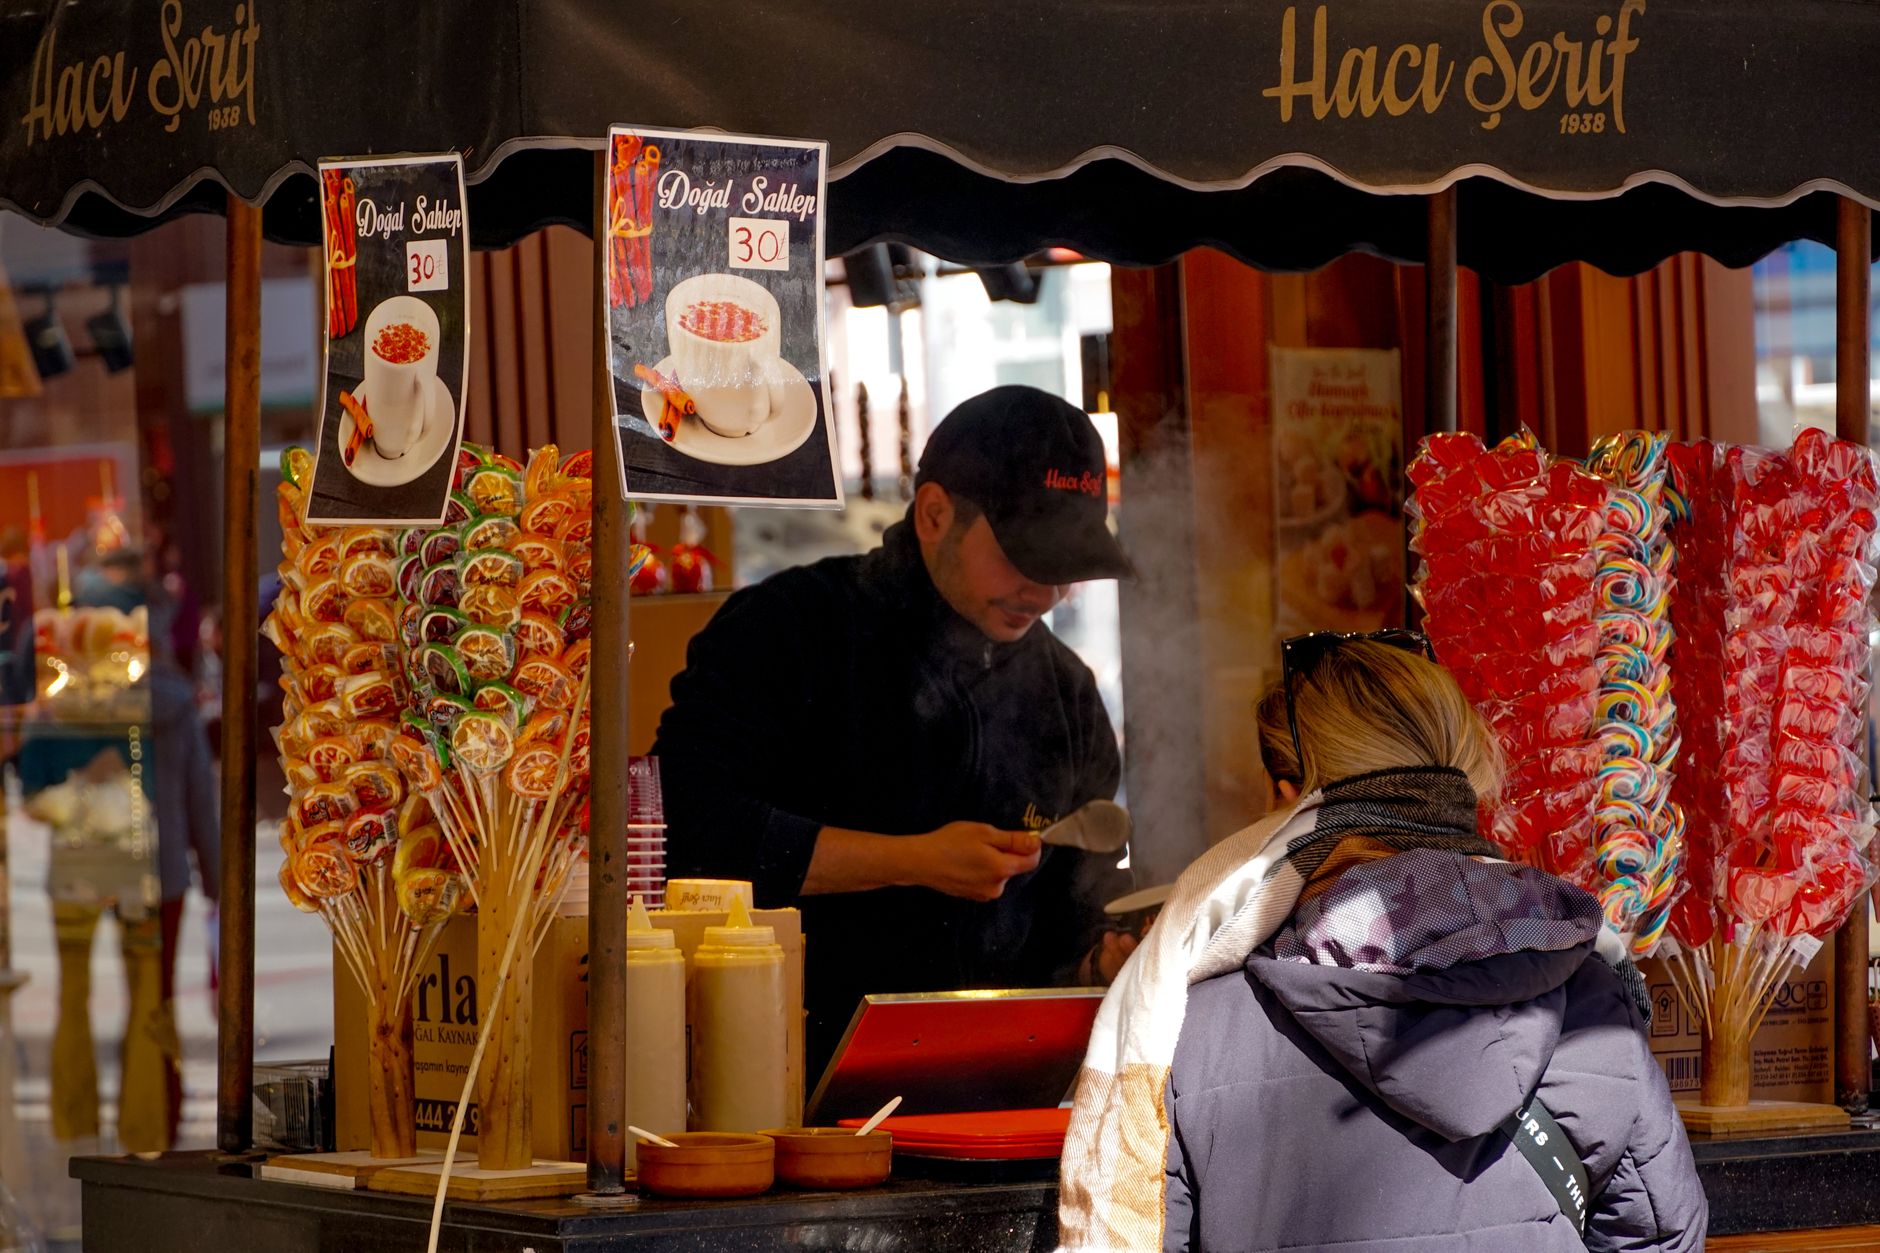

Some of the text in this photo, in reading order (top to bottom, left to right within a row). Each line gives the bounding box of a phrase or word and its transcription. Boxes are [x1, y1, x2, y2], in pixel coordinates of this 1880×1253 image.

[1262, 0, 1646, 134] Hacı Şerif
[208, 106, 240, 131] 1938
[1559, 113, 1605, 134] 1938
[657, 169, 817, 222] Doğal Sahlep
[356, 195, 462, 240] Doğal Sahlep
[413, 953, 478, 1026] rla
[415, 1023, 434, 1042] ĞAL
[445, 1059, 470, 1076] kayna
[1566, 1174, 1585, 1211] THE
